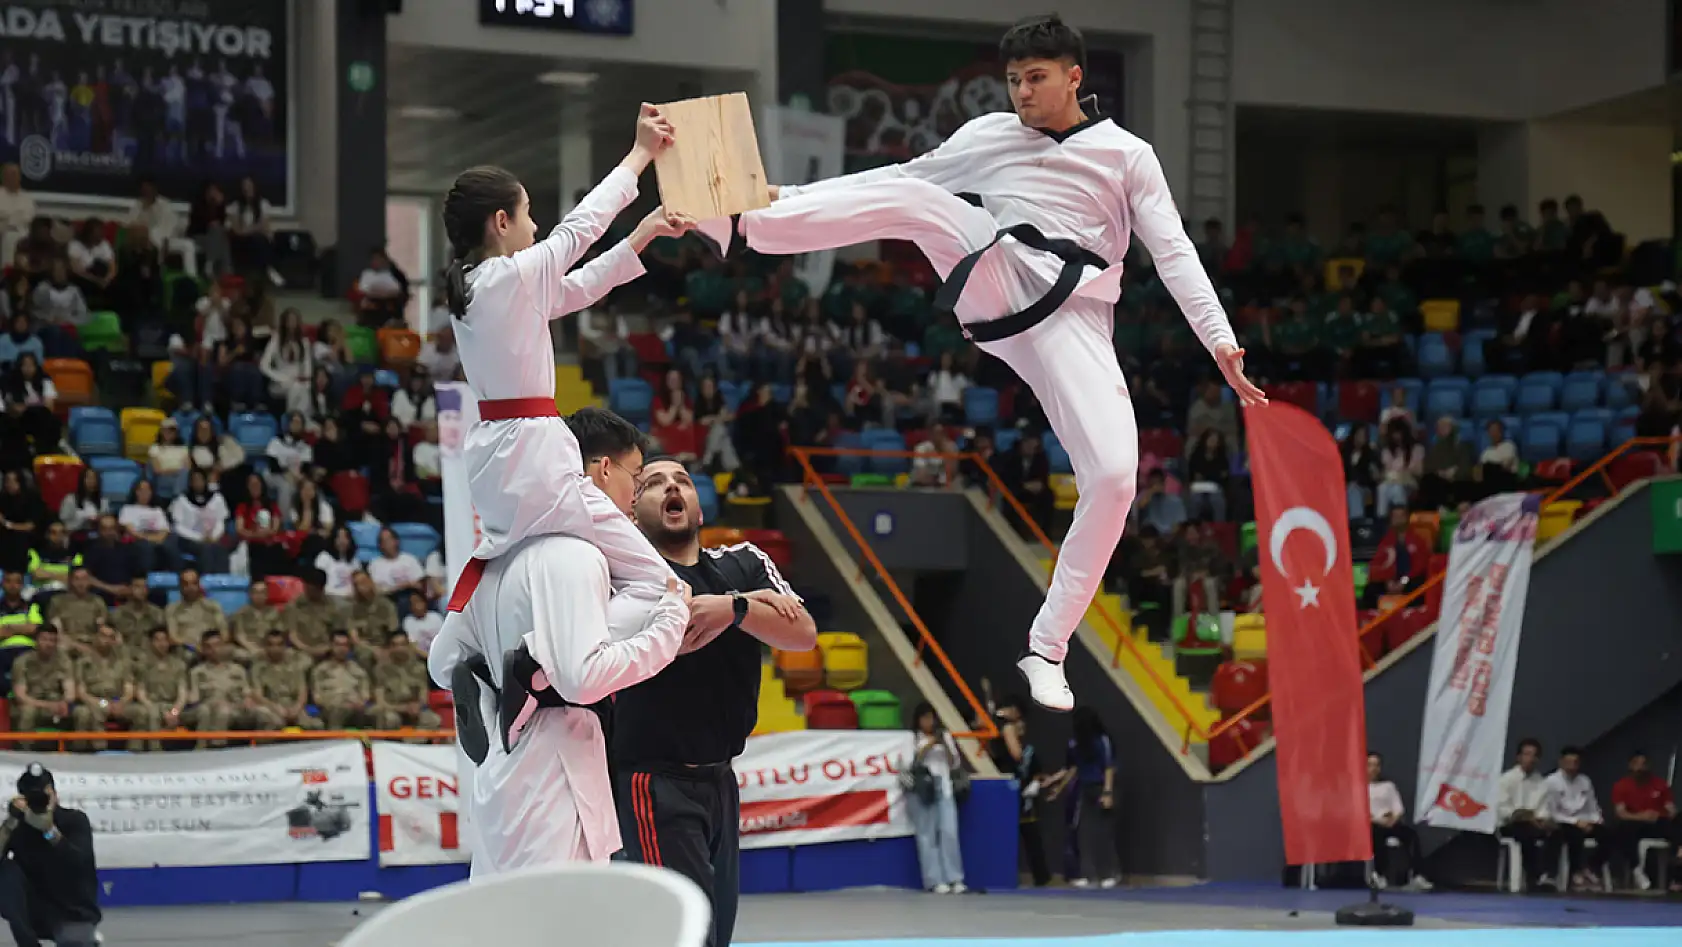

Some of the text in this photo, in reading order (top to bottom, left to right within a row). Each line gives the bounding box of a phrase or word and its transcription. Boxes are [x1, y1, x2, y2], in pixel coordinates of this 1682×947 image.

[0, 6, 272, 59] DA YETİŞİYOR
[388, 775, 460, 799] GEN
[823, 753, 903, 780] OLSU
